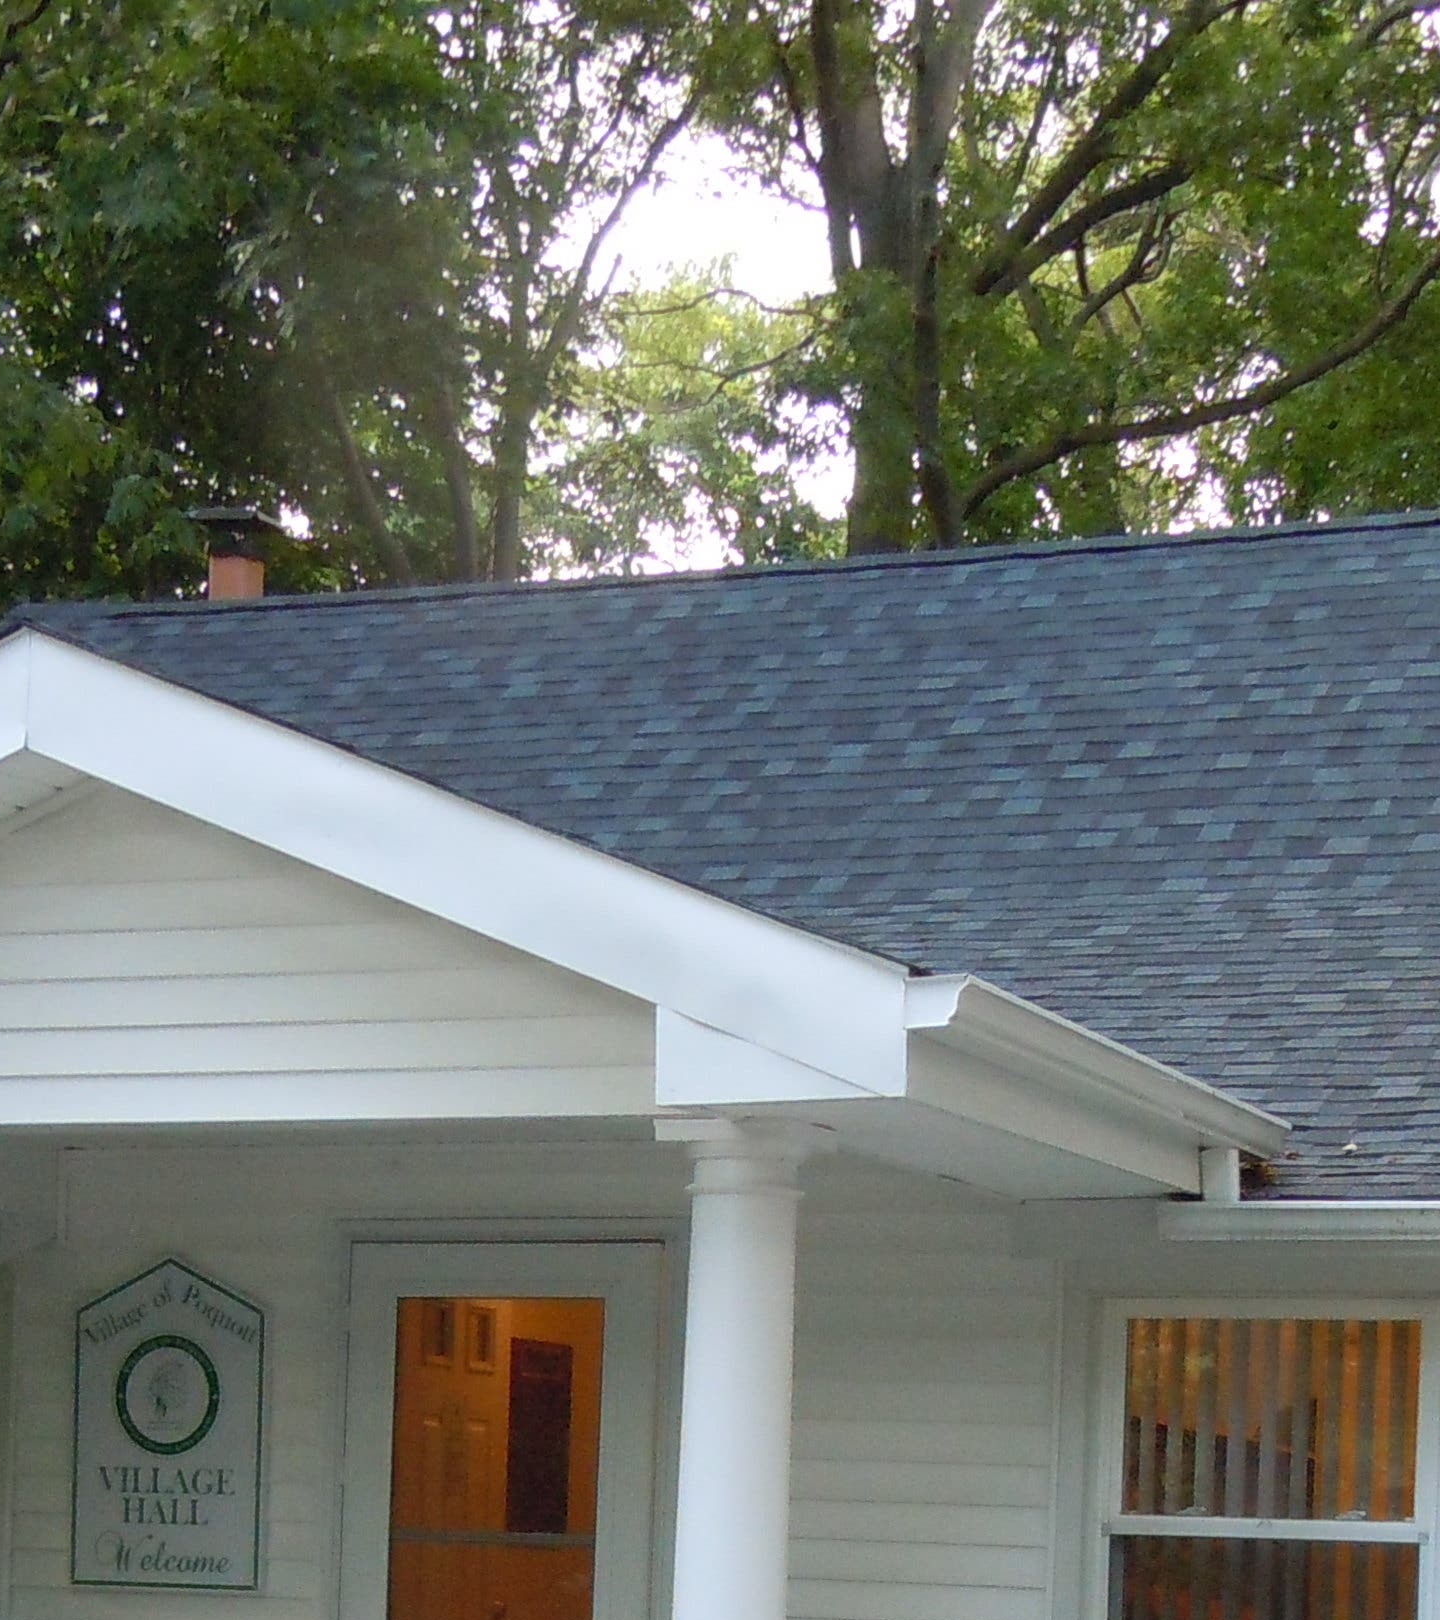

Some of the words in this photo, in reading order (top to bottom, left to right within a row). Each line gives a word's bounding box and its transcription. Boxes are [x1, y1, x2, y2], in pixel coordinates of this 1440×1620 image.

[83, 1302, 147, 1345] Village
[152, 1279, 173, 1308] of
[99, 1465, 236, 1496] VILLAGE
[122, 1497, 209, 1526] HALL
[93, 1529, 232, 1574] Welcome
